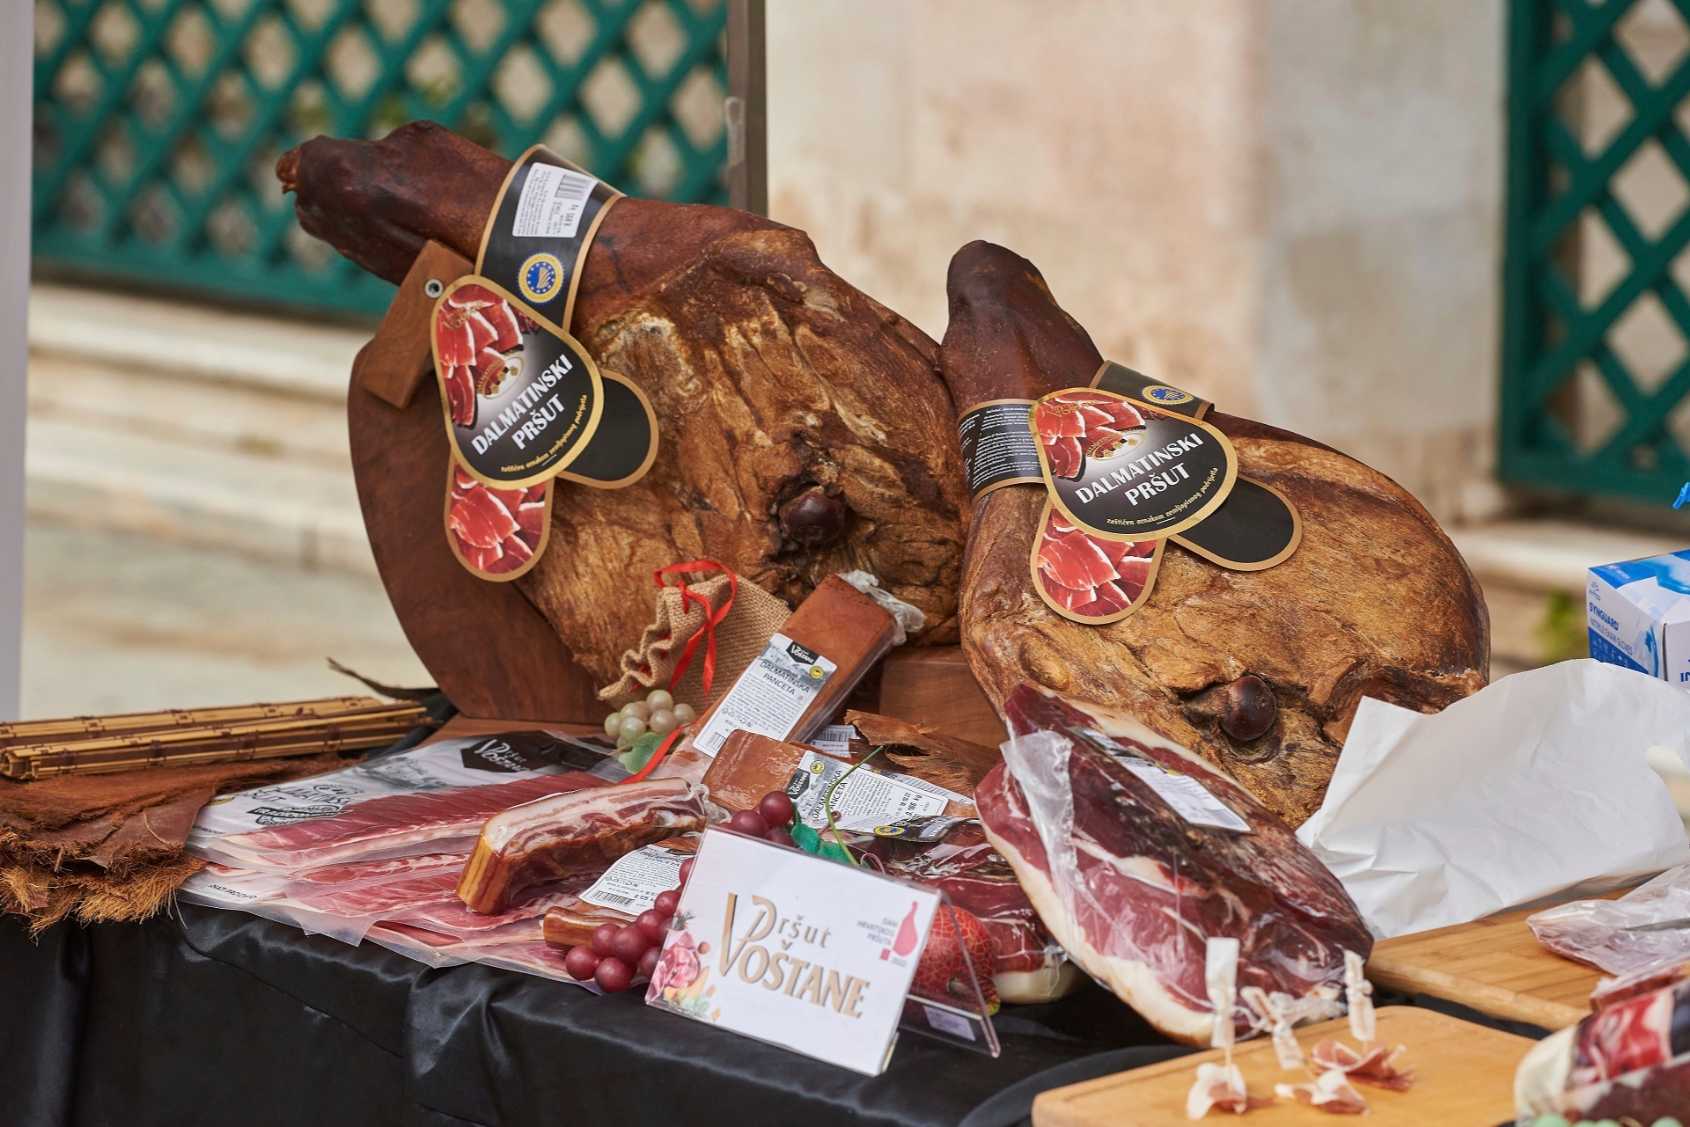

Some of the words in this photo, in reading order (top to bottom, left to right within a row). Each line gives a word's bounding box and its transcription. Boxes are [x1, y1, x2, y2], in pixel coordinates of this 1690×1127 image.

[471, 354, 573, 455] DALMATINSKI
[511, 393, 566, 450] PRŠUT
[1074, 432, 1204, 504] DALMATINSKI
[1124, 462, 1190, 506] PRŠUT
[763, 672, 796, 696] PANCETA
[750, 894, 832, 949] Pršut
[718, 891, 870, 1019] VOŠTANE
